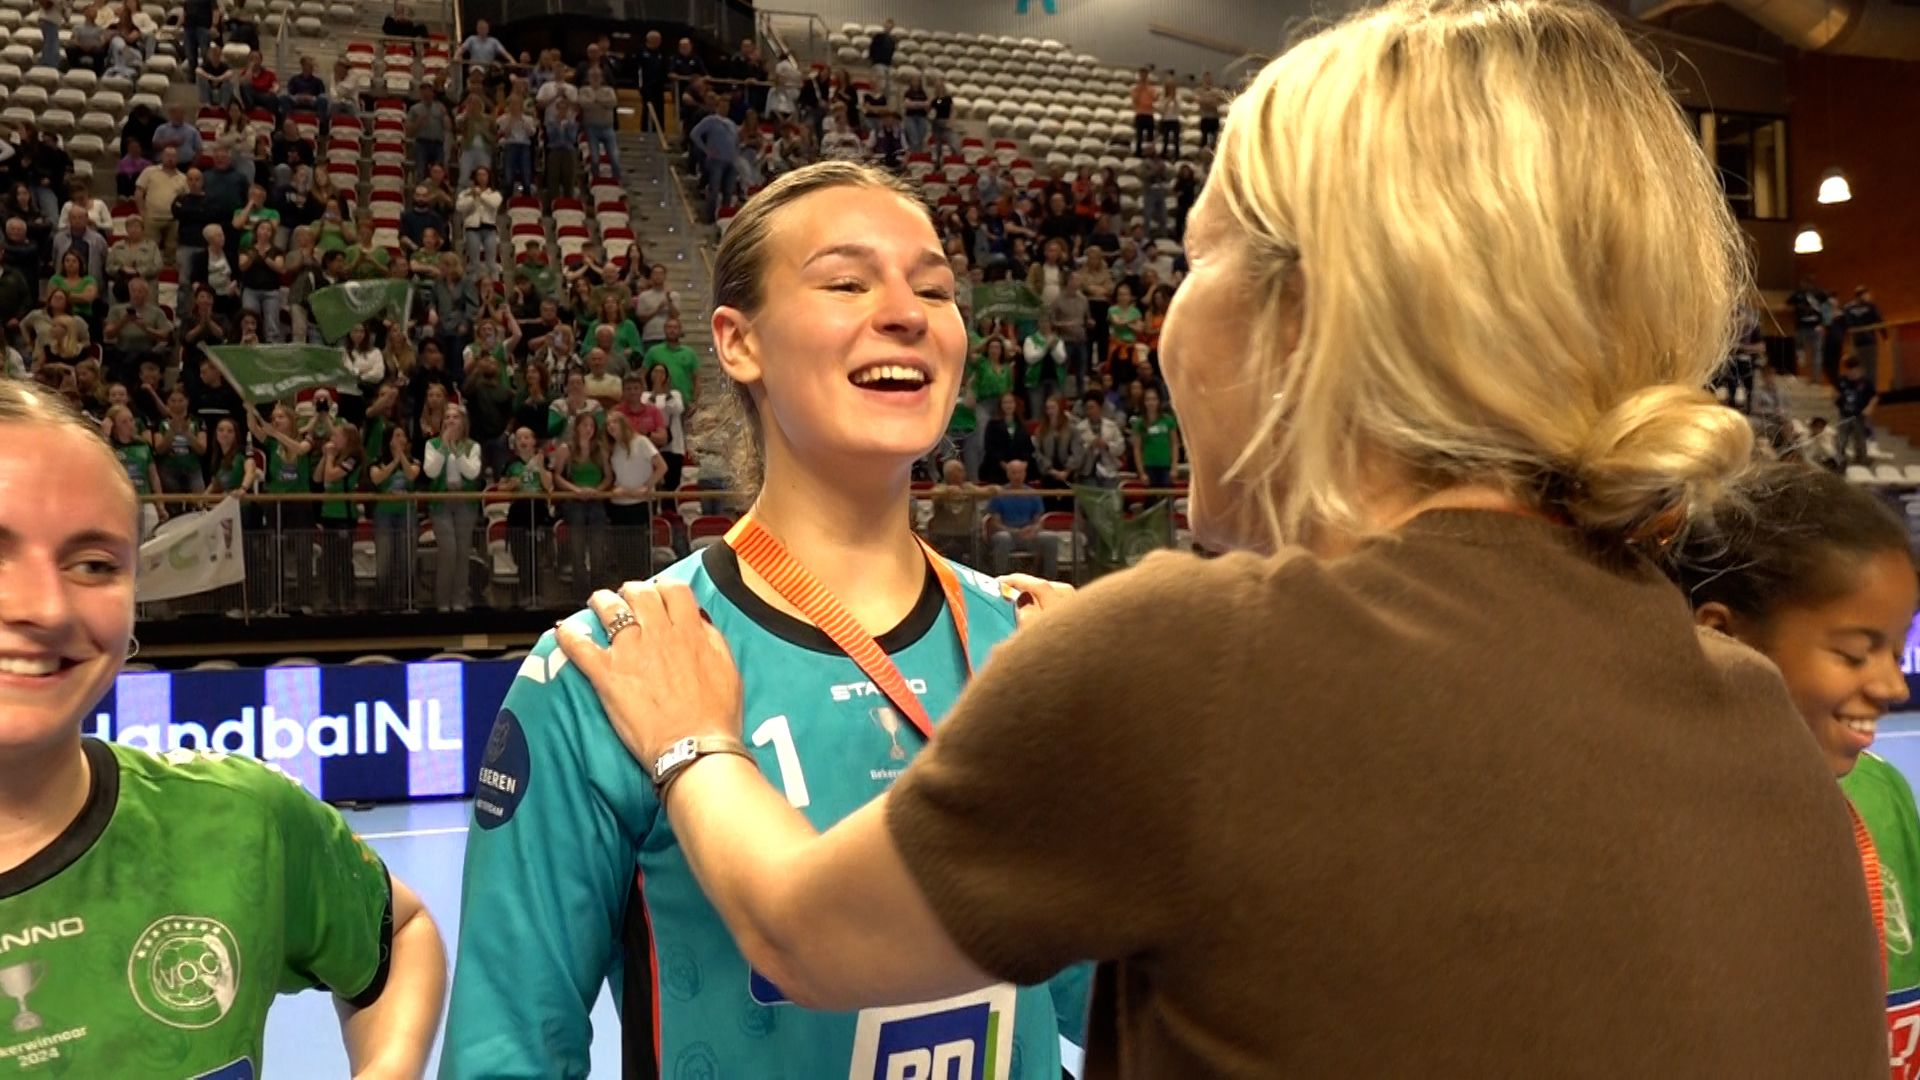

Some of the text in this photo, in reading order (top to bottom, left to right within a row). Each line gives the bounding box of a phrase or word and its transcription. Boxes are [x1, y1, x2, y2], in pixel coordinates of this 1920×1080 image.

[831, 679, 928, 701] STAO
[752, 715, 810, 808] 1
[0, 917, 84, 954] NNO
[160, 952, 219, 989] VOC
[18, 1047, 60, 1067] 2024
